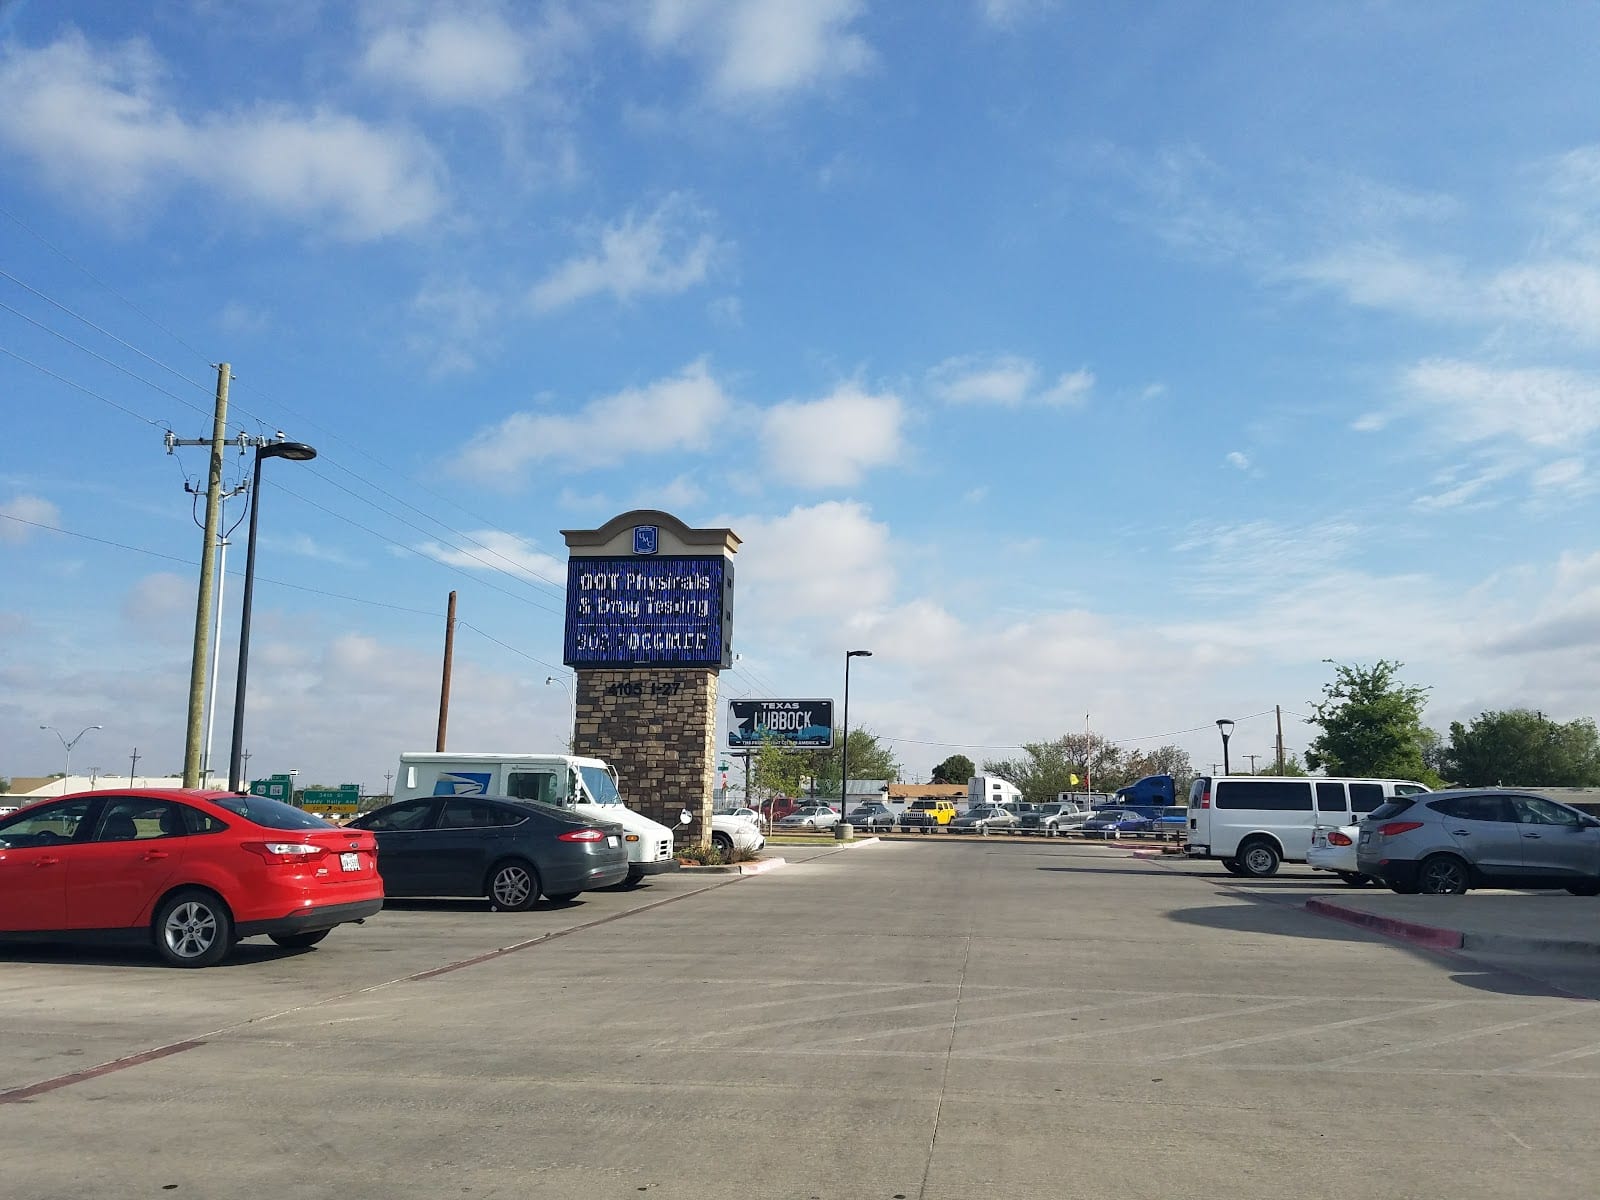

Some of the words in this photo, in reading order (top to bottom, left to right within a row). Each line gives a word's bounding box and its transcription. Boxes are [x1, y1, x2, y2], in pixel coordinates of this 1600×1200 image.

[598, 597, 640, 617] Drug
[607, 682, 642, 696] 4105
[760, 702, 800, 710] TEXAS
[753, 711, 812, 731] LUBBOCK
